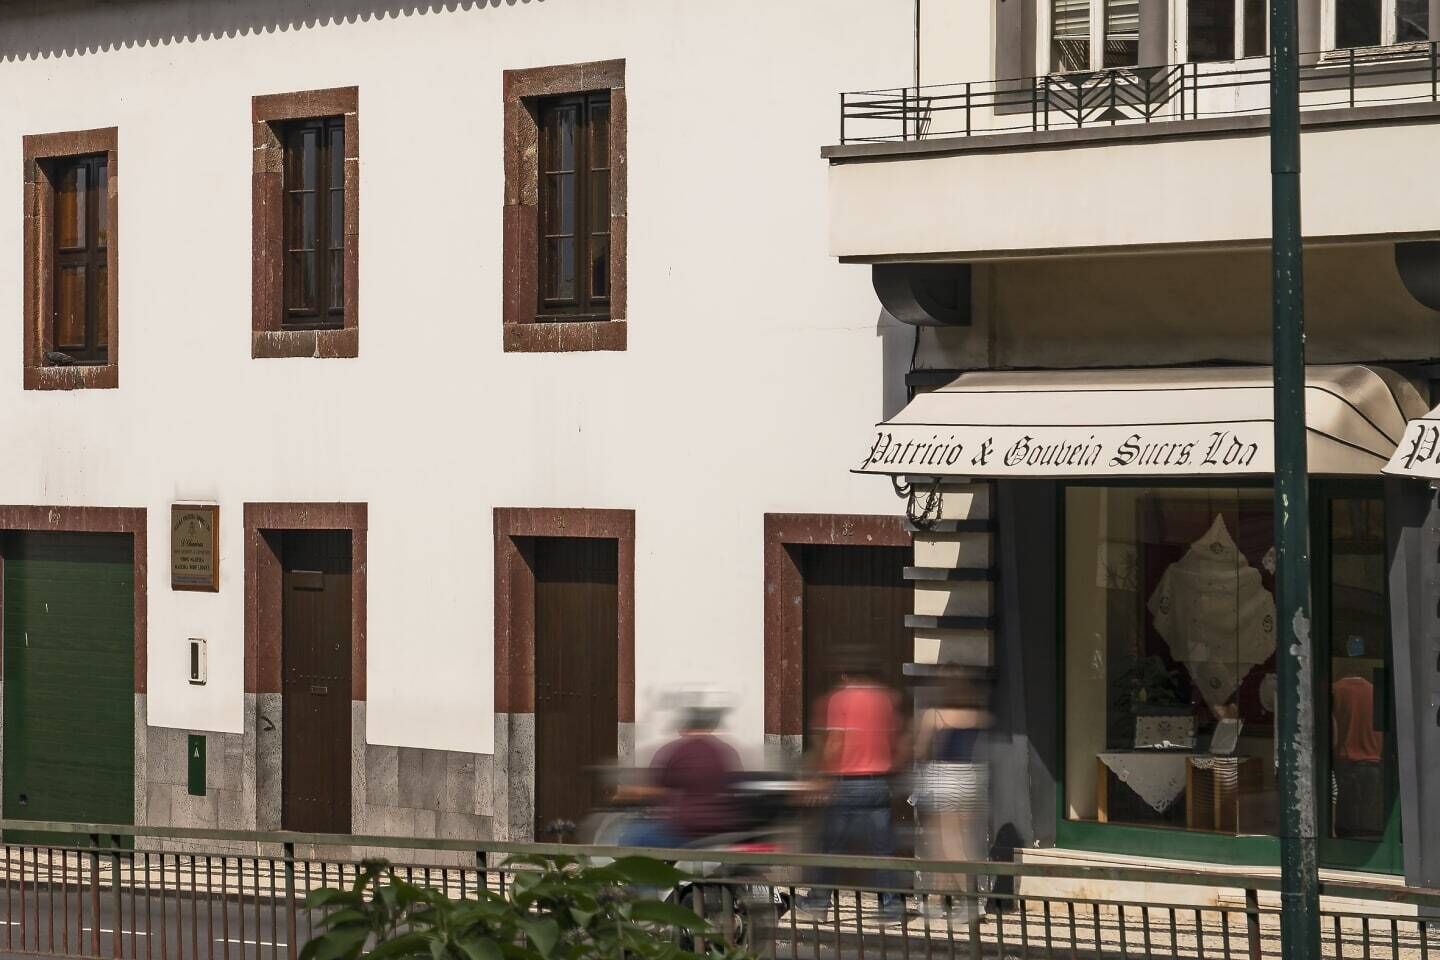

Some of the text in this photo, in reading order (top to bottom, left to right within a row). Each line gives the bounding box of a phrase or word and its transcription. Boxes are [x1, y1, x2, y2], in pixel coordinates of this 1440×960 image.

[861, 431, 964, 470] Patricio
[970, 436, 994, 467] &
[1003, 434, 1103, 467] Gouveia
[1201, 430, 1258, 467] Lda
